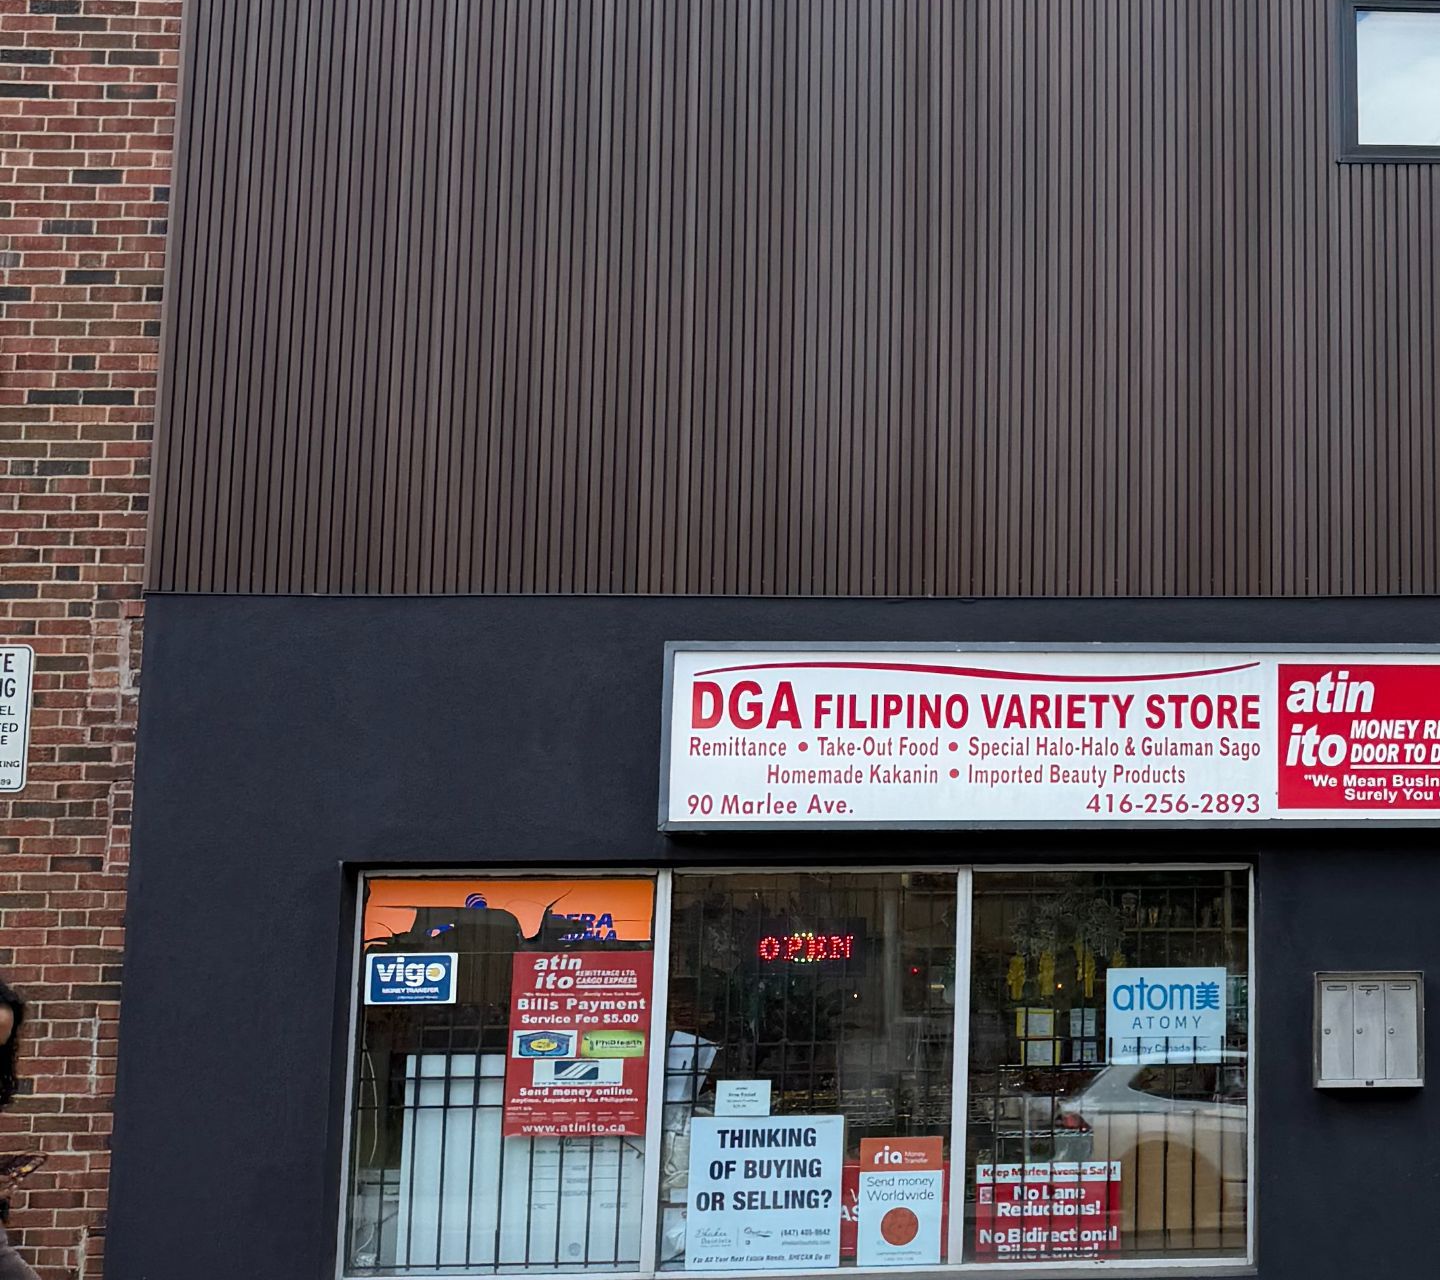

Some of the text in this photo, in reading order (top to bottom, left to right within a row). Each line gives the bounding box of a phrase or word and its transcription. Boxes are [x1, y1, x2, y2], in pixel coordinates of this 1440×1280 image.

[0, 653, 15, 672] E
[1286, 670, 1375, 714] atin
[691, 681, 1261, 729] DGA FILIPINO VARIETY STORE
[1350, 719, 1420, 740] MONEY
[689, 736, 1261, 761] Remittance Take-Out Food Special Halo-Halo & Gulaman Sago
[1285, 723, 1347, 767] ito
[1350, 743, 1400, 763] DOOR
[1403, 743, 1425, 763] TO
[767, 764, 1186, 788] Homemade Kakanin Imported Beauty Products
[1303, 774, 1338, 787] "We
[1342, 774, 1387, 787] Mean
[688, 793, 1261, 814] 90 Marlee Ave. 416-256-2893
[1344, 788, 1397, 803] Surely
[1402, 788, 1434, 801] You
[760, 936, 854, 959] OPEN
[533, 954, 582, 970] atin
[376, 956, 446, 987] vigo
[535, 972, 574, 989] ito
[575, 977, 603, 985] CARGO
[517, 998, 646, 1013] Bills Payment
[521, 1013, 639, 1024] Service Fee $5.00
[1133, 1016, 1201, 1029] ATOMY
[519, 1086, 633, 1098] Send money online
[522, 1122, 625, 1132] www.atinito.ca
[717, 1128, 817, 1148] THINKING
[874, 1146, 902, 1164] ria
[709, 1159, 821, 1180] OF BUYING
[867, 1177, 934, 1187] Send money
[696, 1192, 725, 1211] OR
[732, 1189, 833, 1210] SELLING?
[867, 1190, 934, 1201] Worldwide
[1013, 1186, 1039, 1200] No
[980, 1229, 1005, 1243] No
